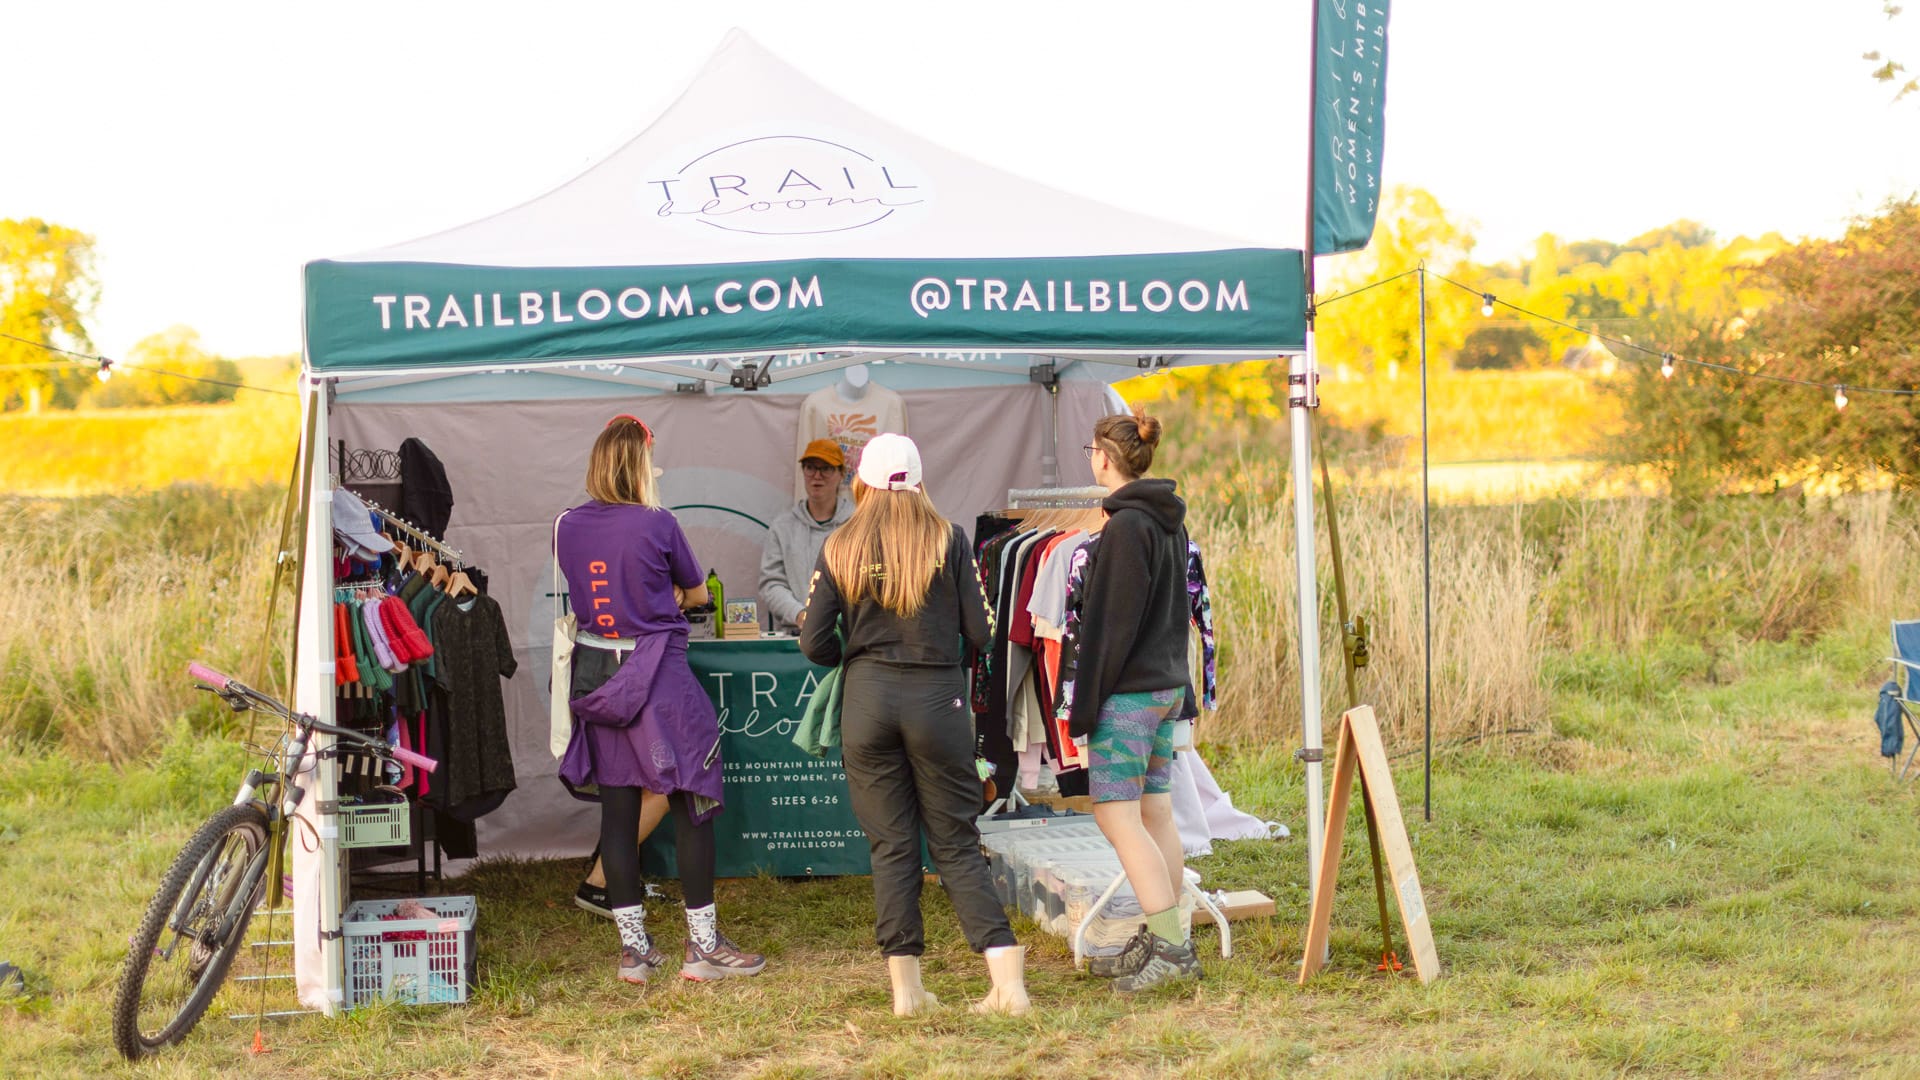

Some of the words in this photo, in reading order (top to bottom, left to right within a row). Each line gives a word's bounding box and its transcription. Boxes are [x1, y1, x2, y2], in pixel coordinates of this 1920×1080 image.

[1355, 2, 1367, 59] MTB
[1330, 40, 1346, 194] TRAIL
[1348, 70, 1363, 204] WOMEN'S
[648, 166, 918, 201] TRAIL
[657, 197, 925, 217] bloom
[372, 274, 824, 330] TRAILBLOOM.COM
[910, 276, 1250, 319] @TRAILBLOOM
[709, 669, 820, 708] TRA
[716, 707, 802, 737] blo
[744, 761, 803, 769] MOUNTAIN
[783, 774, 828, 782] WOMEN,
[771, 796, 807, 806] SIZES
[811, 795, 839, 805] 6-26
[767, 841, 845, 851] @TRAILBLOOM
